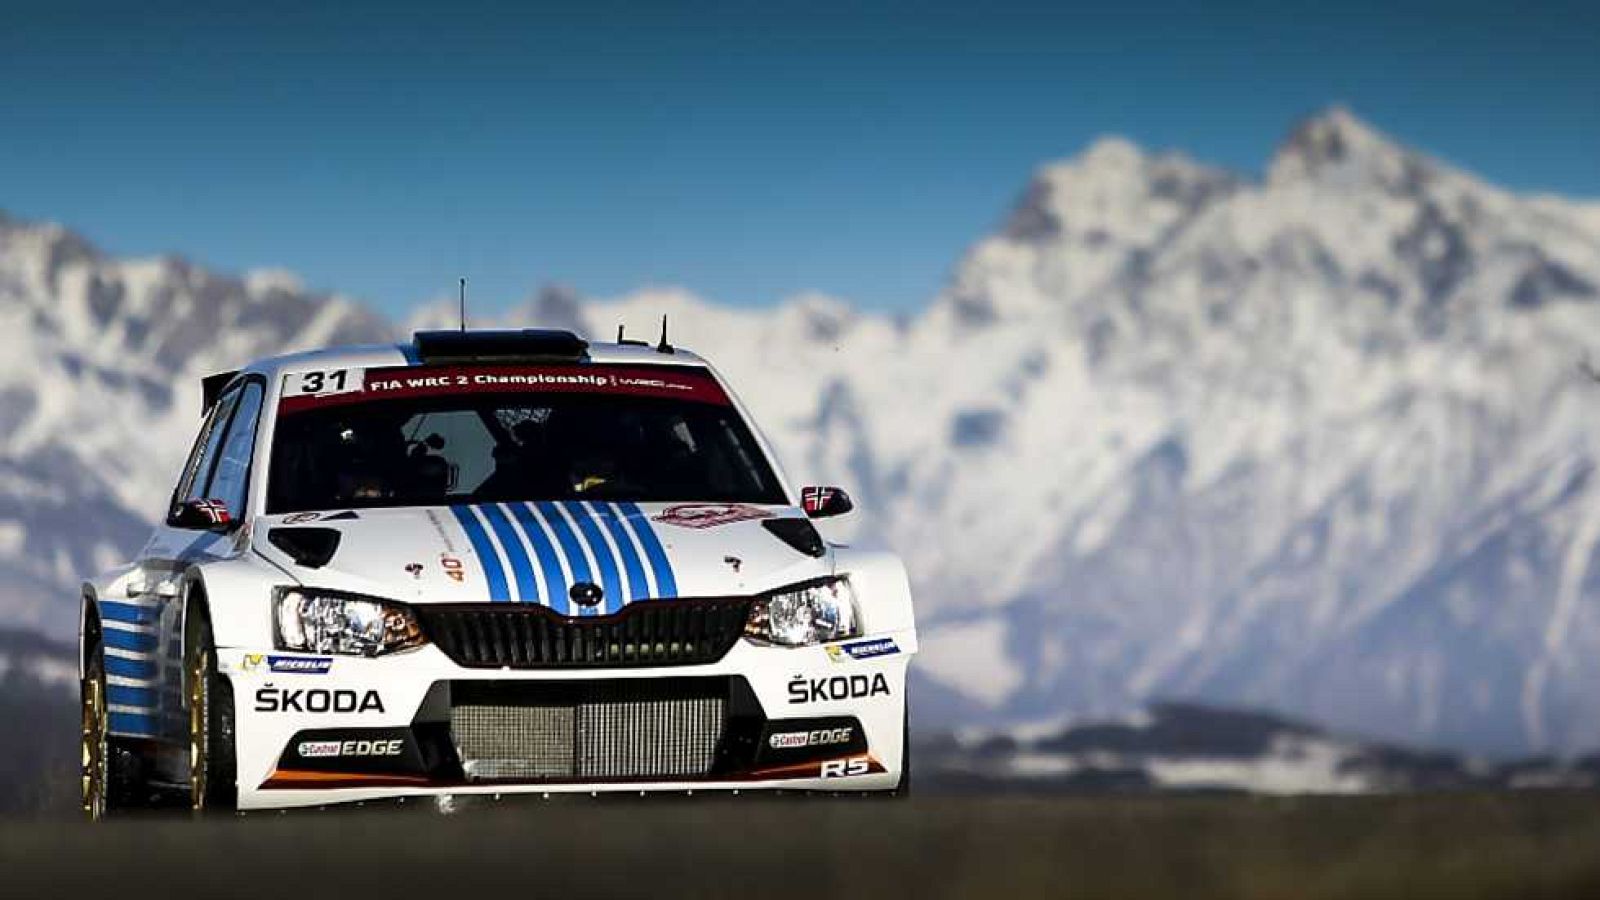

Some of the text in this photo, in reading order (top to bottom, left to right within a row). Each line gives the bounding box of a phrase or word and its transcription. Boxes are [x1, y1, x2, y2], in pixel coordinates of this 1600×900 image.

[301, 371, 348, 393] 31
[370, 374, 607, 391] FIA WRC 2 Championship
[254, 682, 385, 713] ŠKODA
[787, 673, 891, 704] ŠKODA
[809, 728, 852, 745] EDGE
[342, 740, 403, 756] EDGE
